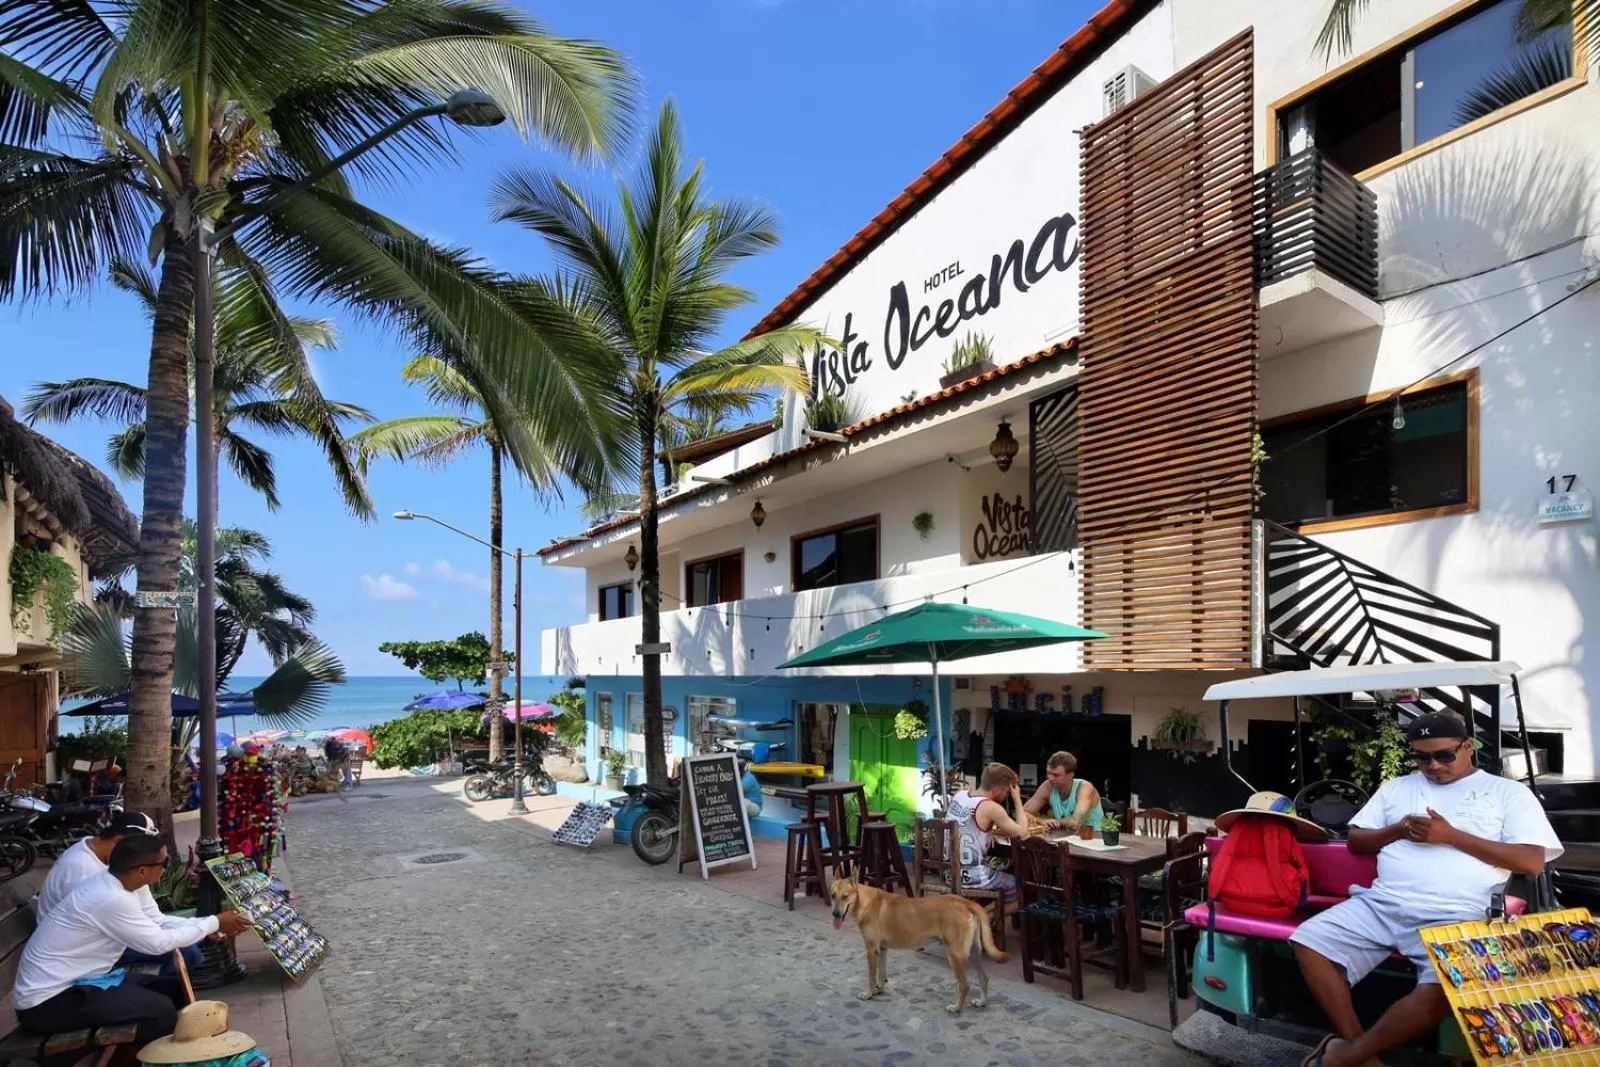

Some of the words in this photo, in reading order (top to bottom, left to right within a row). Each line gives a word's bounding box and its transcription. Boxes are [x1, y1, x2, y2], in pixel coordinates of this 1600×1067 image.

[884, 212, 1079, 371] Oceana
[924, 261, 965, 293] HOTEL
[1546, 475, 1577, 494] 17
[981, 492, 1031, 534] Vista
[973, 523, 1031, 560] Ocean
